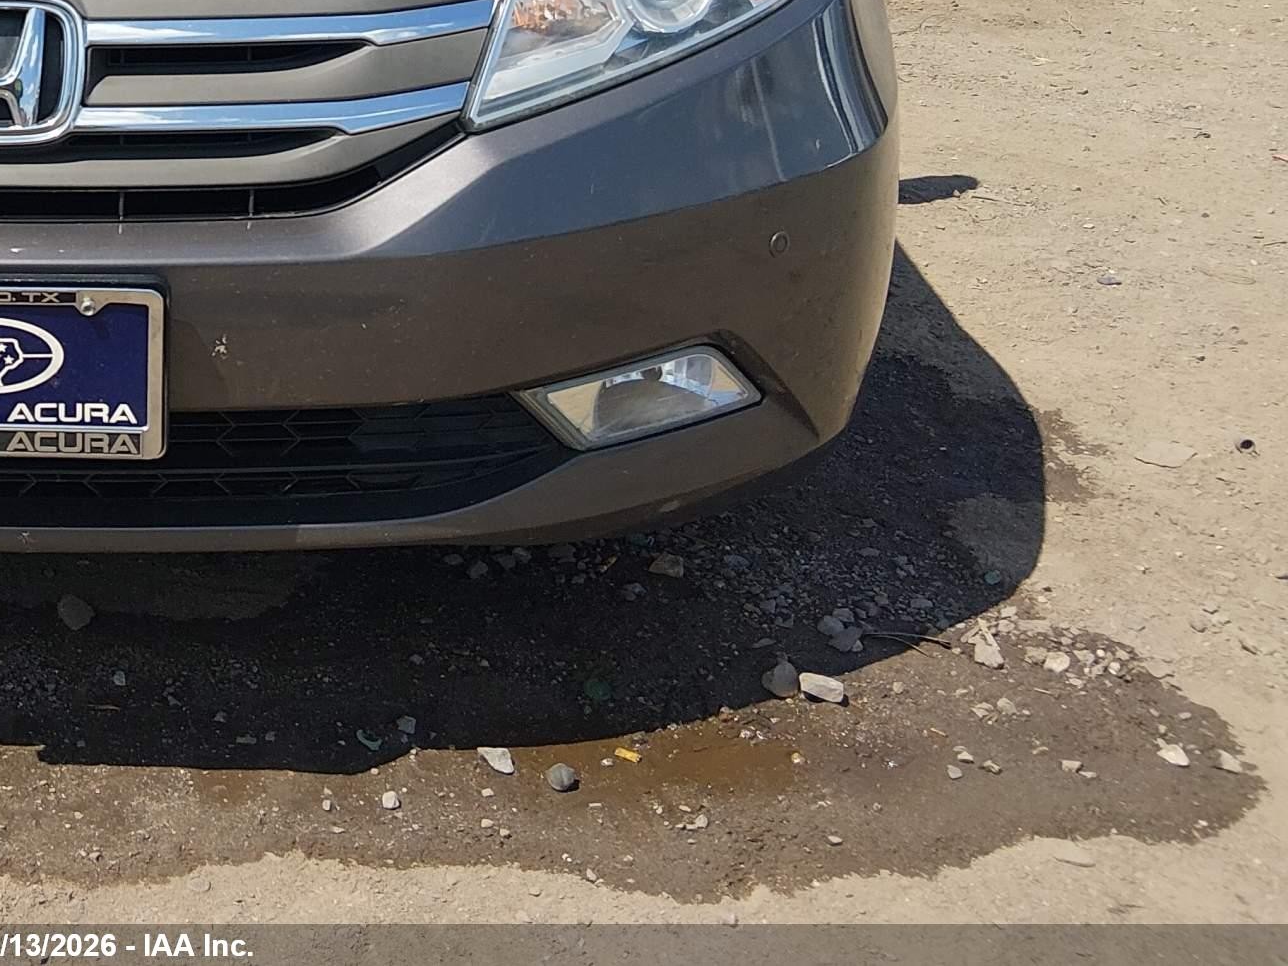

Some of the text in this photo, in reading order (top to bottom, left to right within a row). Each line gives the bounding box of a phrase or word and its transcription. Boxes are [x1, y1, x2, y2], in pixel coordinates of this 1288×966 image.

[21, 291, 60, 303] TX
[7, 402, 138, 424] ACURA
[6, 431, 139, 454] ACURA
